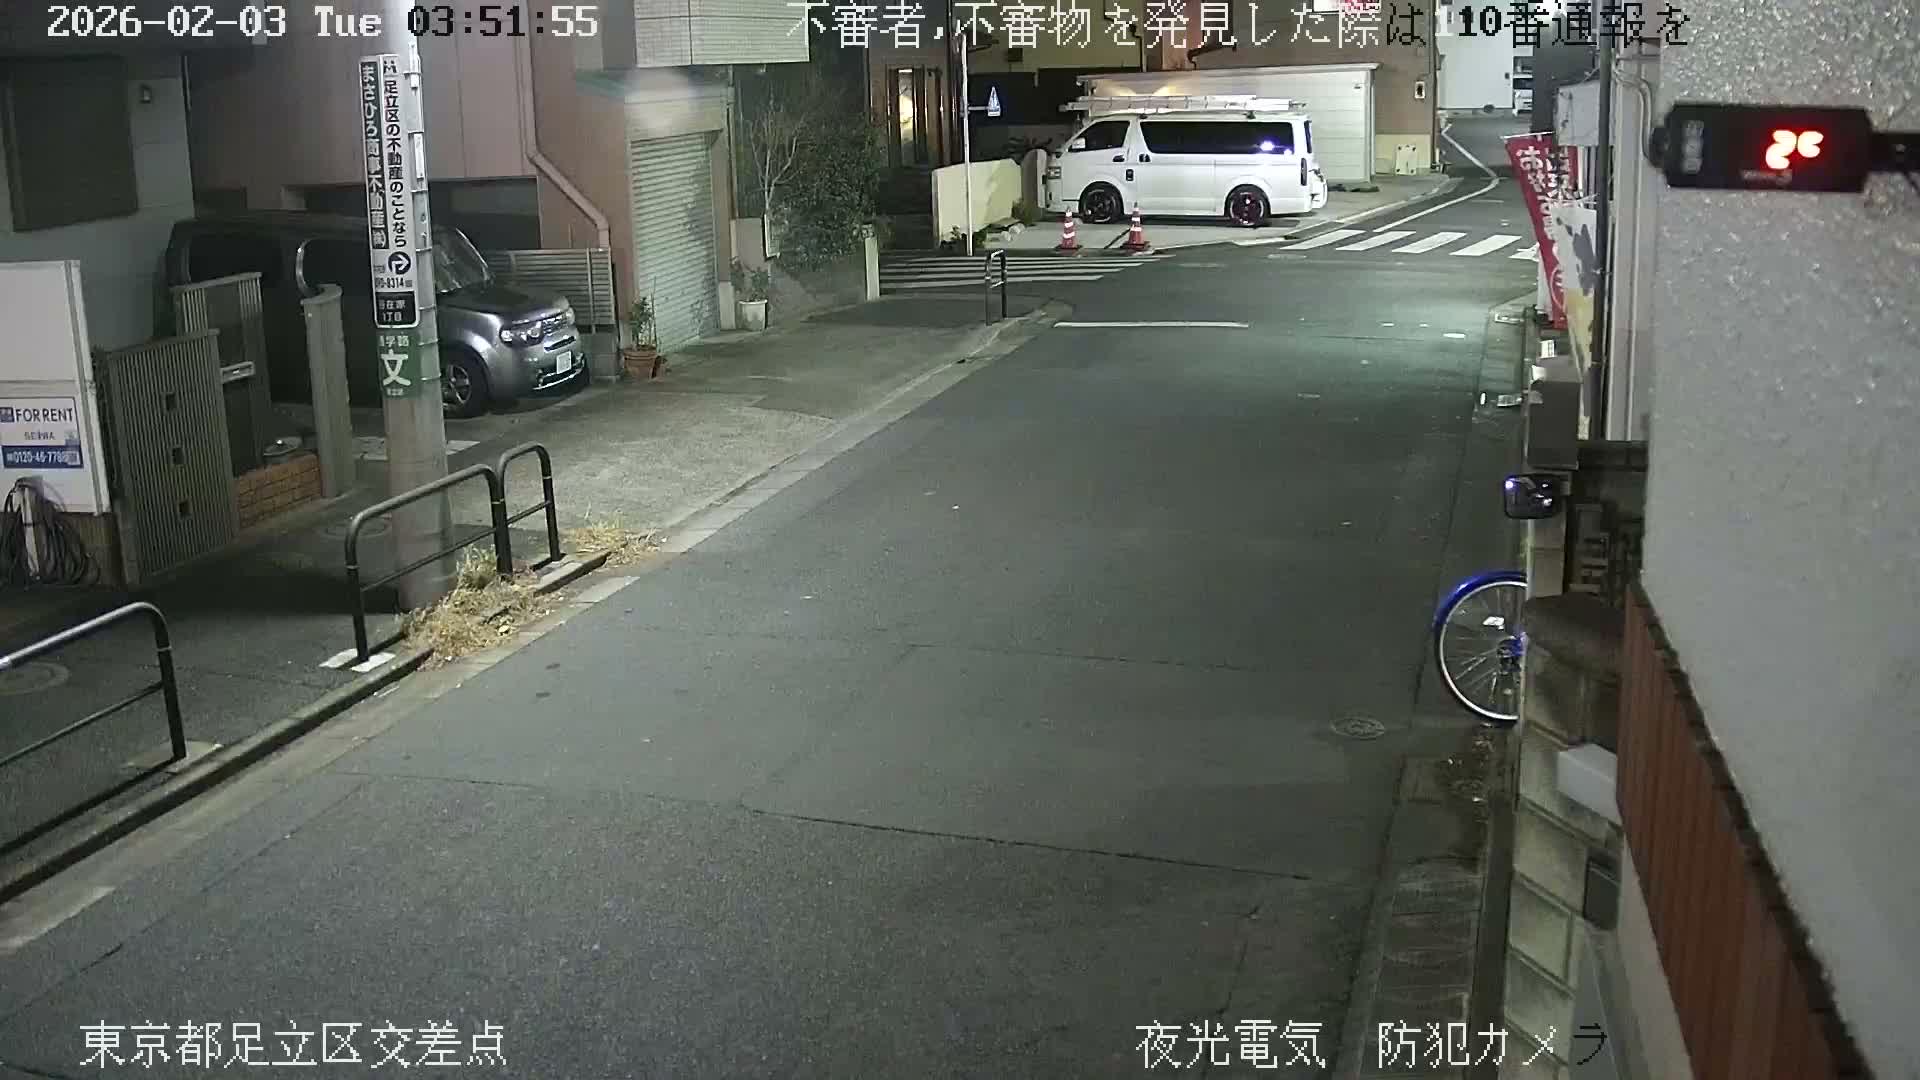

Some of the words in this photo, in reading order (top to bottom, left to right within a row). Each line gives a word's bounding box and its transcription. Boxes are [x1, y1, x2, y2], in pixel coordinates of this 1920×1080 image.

[383, 79, 408, 248] 足立区の不動産のことなら
[380, 348, 412, 386] 文
[16, 407, 41, 422] FOR
[42, 407, 73, 422] RENT
